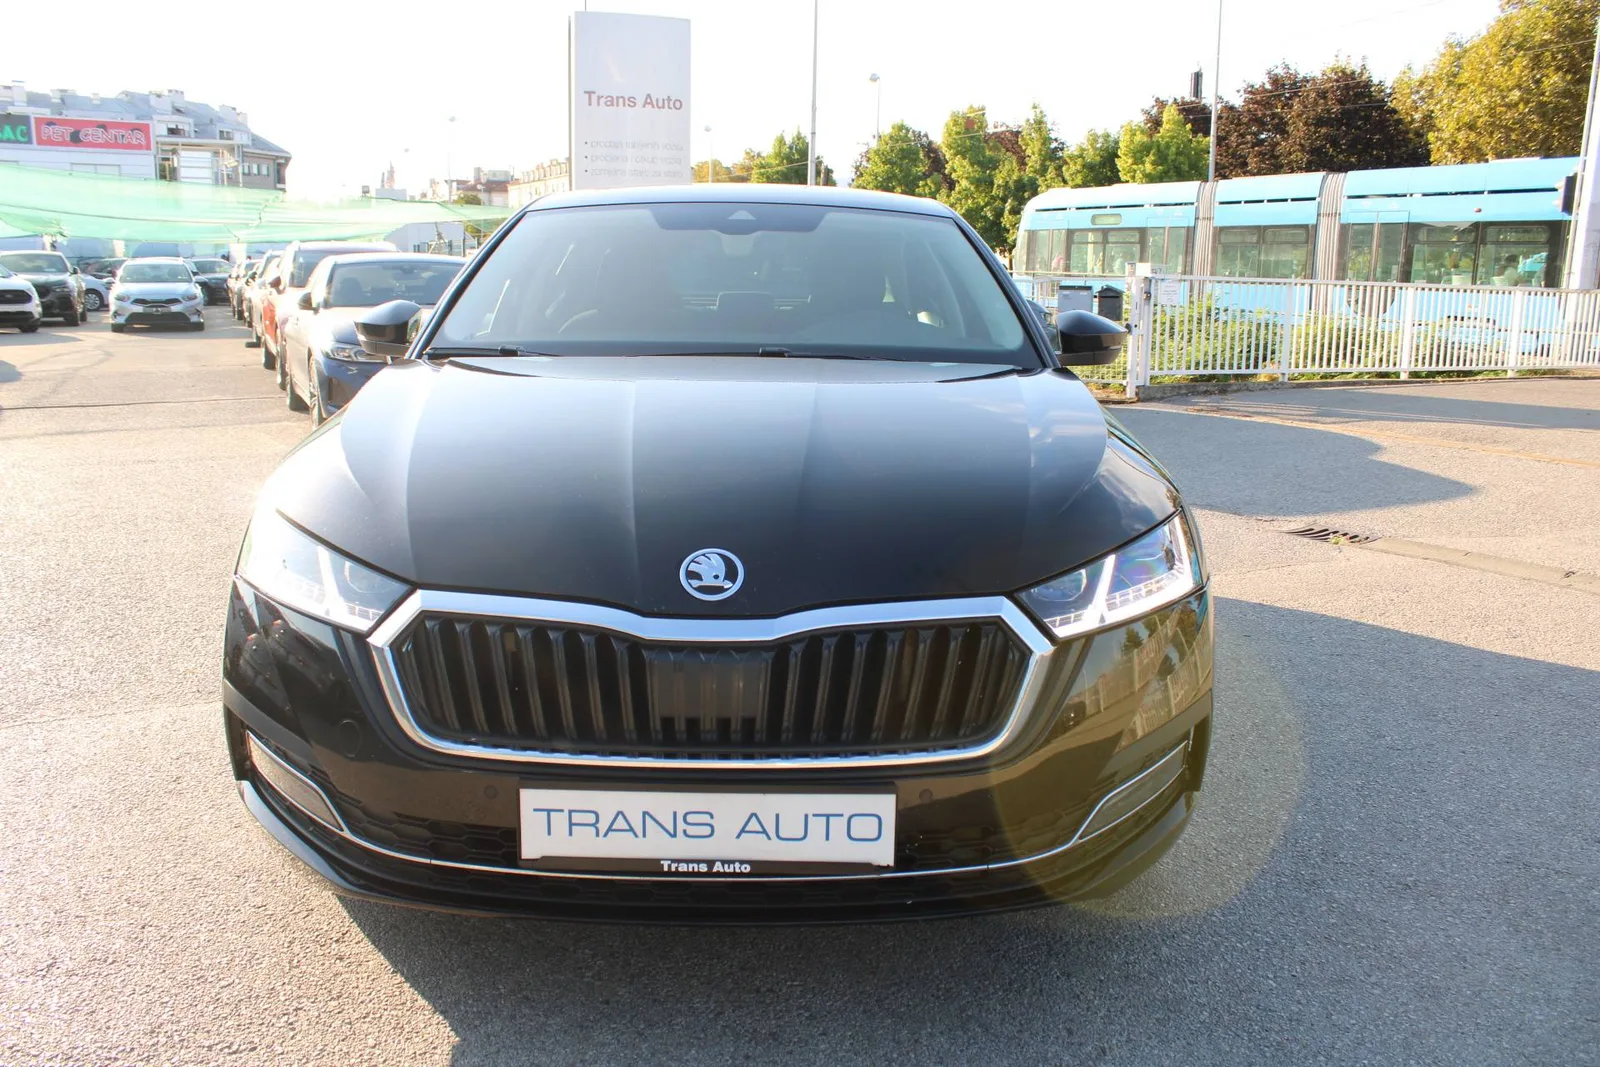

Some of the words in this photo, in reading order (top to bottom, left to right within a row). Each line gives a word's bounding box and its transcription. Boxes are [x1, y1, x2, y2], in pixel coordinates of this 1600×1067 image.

[583, 90, 637, 108] Trans
[642, 93, 683, 110] Auto
[0, 124, 28, 142] AC
[41, 124, 74, 142] PET
[79, 127, 147, 145] CENTAR
[532, 808, 716, 840] TRANS
[735, 811, 883, 843] AUTO
[660, 860, 708, 872] Trans
[712, 861, 751, 873] Auto
